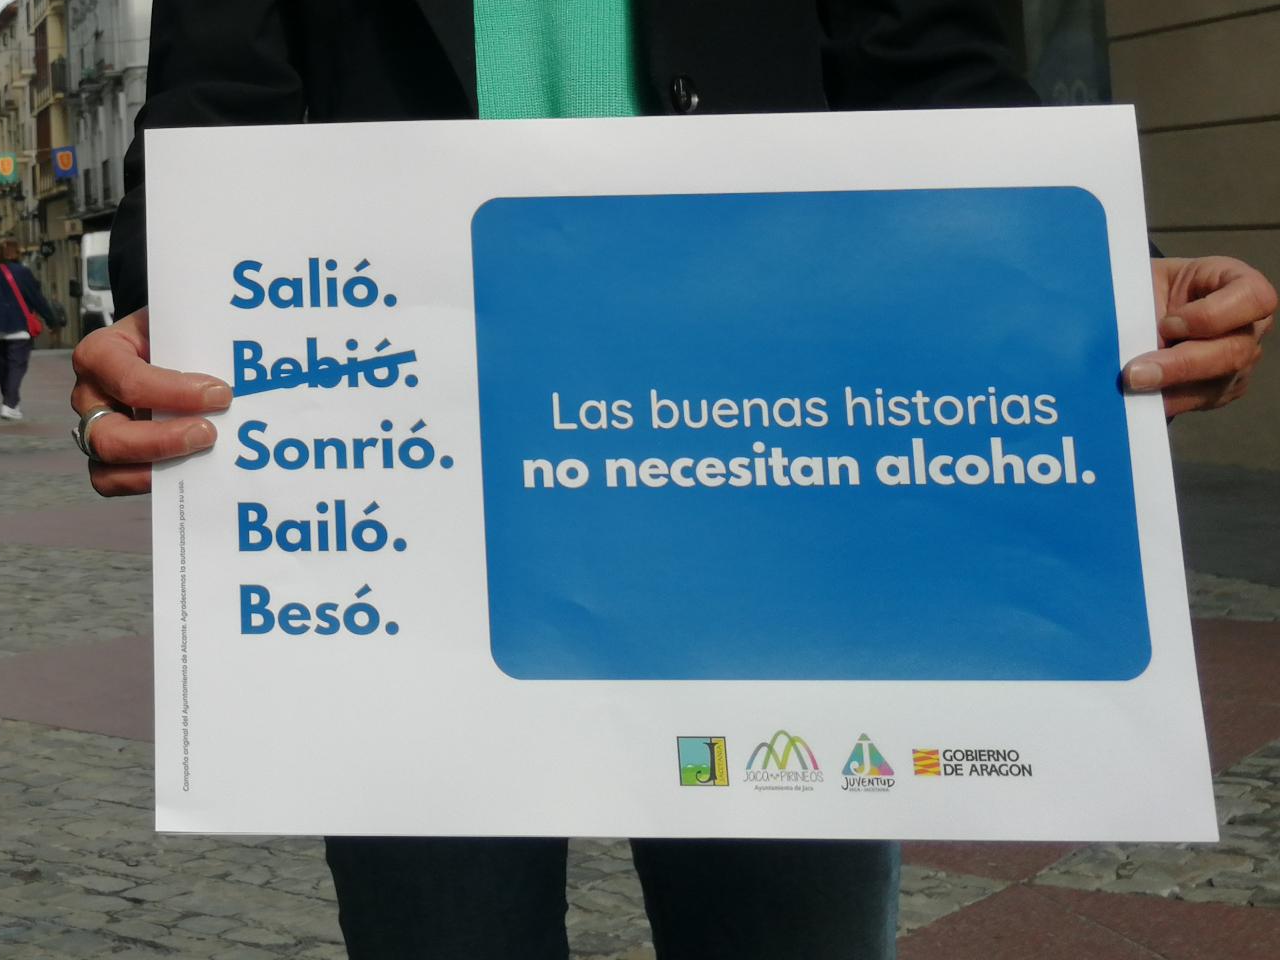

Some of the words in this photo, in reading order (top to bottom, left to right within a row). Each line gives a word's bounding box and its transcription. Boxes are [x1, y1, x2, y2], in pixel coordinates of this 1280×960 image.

[230, 257, 398, 310] Salió.
[232, 337, 419, 398] Bebió.
[552, 392, 634, 430] Las
[650, 389, 830, 429] buenas
[845, 386, 1059, 427] historias
[235, 420, 455, 472] Sonrió.
[523, 458, 590, 489] no
[605, 441, 861, 488] necesitan
[876, 435, 1097, 486] alcohol.
[178, 504, 186, 521] para
[237, 500, 408, 553] Bailó.
[179, 565, 186, 573] la
[179, 574, 188, 622] Agradecemos
[239, 584, 400, 637] Besó.
[180, 654, 188, 663] de
[181, 664, 189, 714] Ayuntamiento
[181, 715, 189, 727] del
[181, 728, 190, 755] original
[942, 748, 1020, 762] GOBIERNO
[182, 756, 190, 792] Campaña
[840, 776, 896, 791] JUVENTUD
[943, 763, 965, 777] DE
[969, 763, 1033, 778] ARAGON
